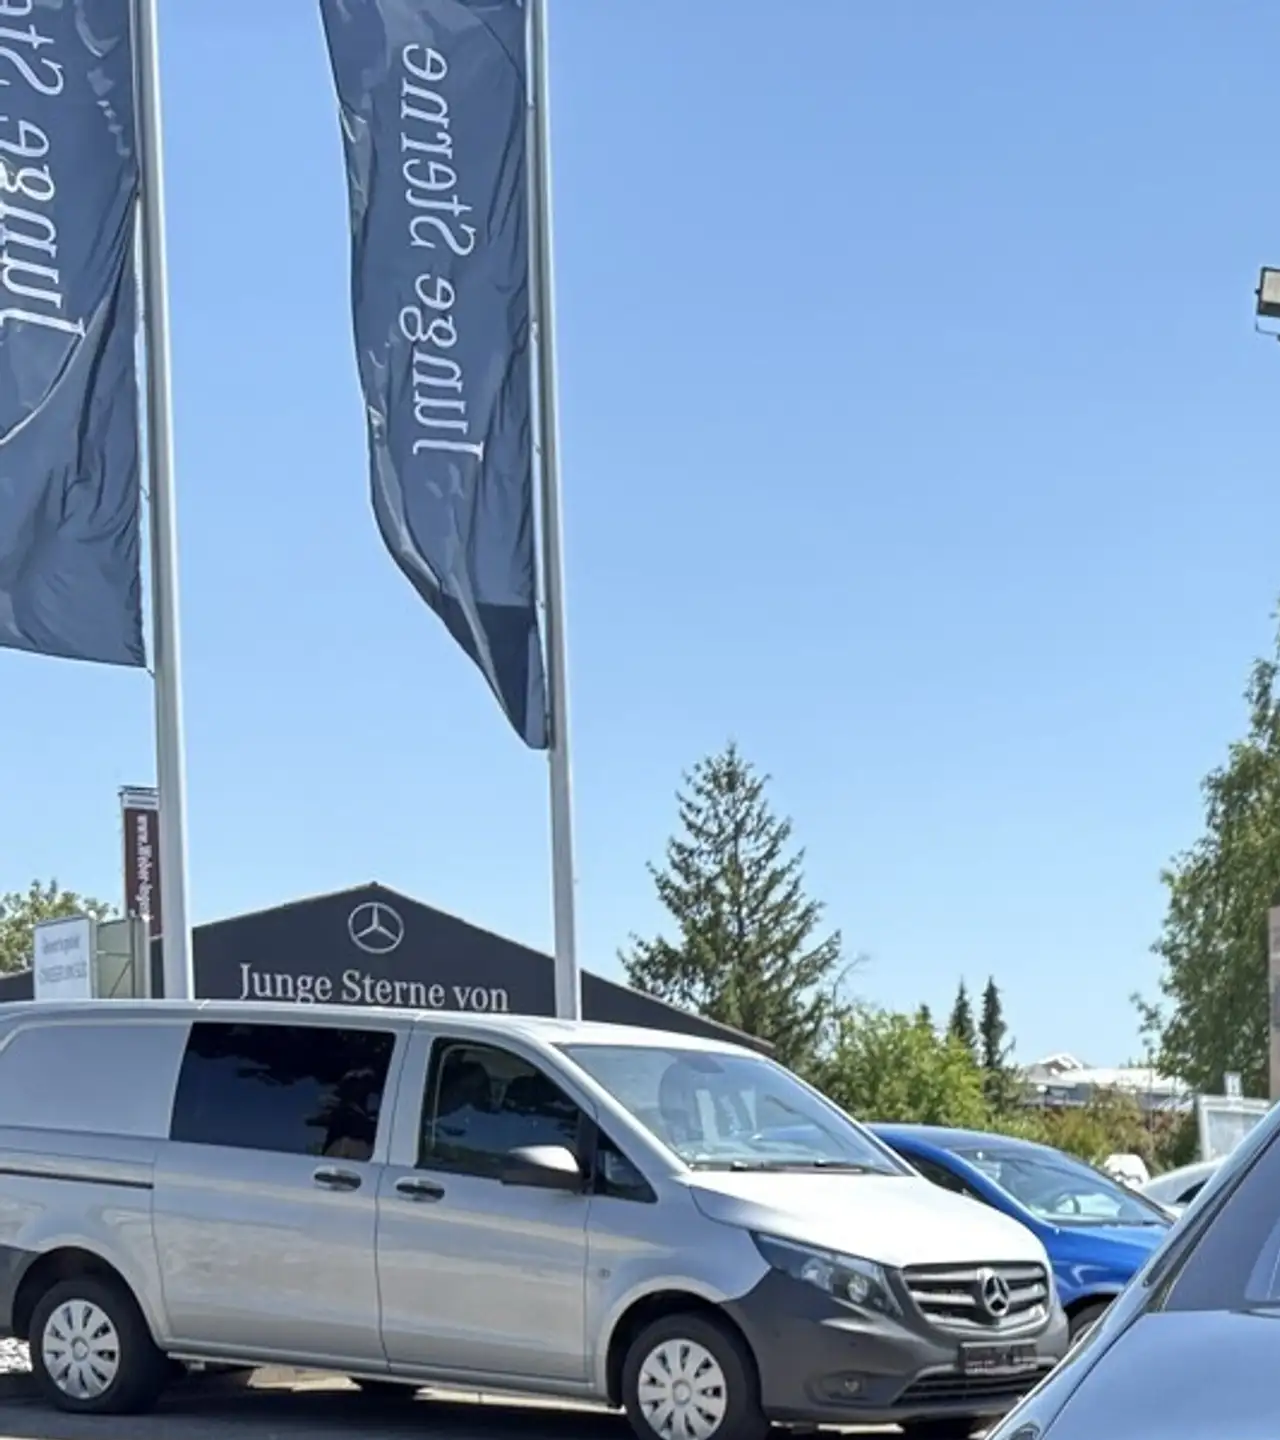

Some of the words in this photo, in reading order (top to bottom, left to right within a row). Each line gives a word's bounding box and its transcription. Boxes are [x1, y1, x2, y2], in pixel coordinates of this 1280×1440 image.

[239, 962, 333, 1004] Junge
[341, 968, 446, 1008] Sterne
[452, 985, 510, 1012] von
